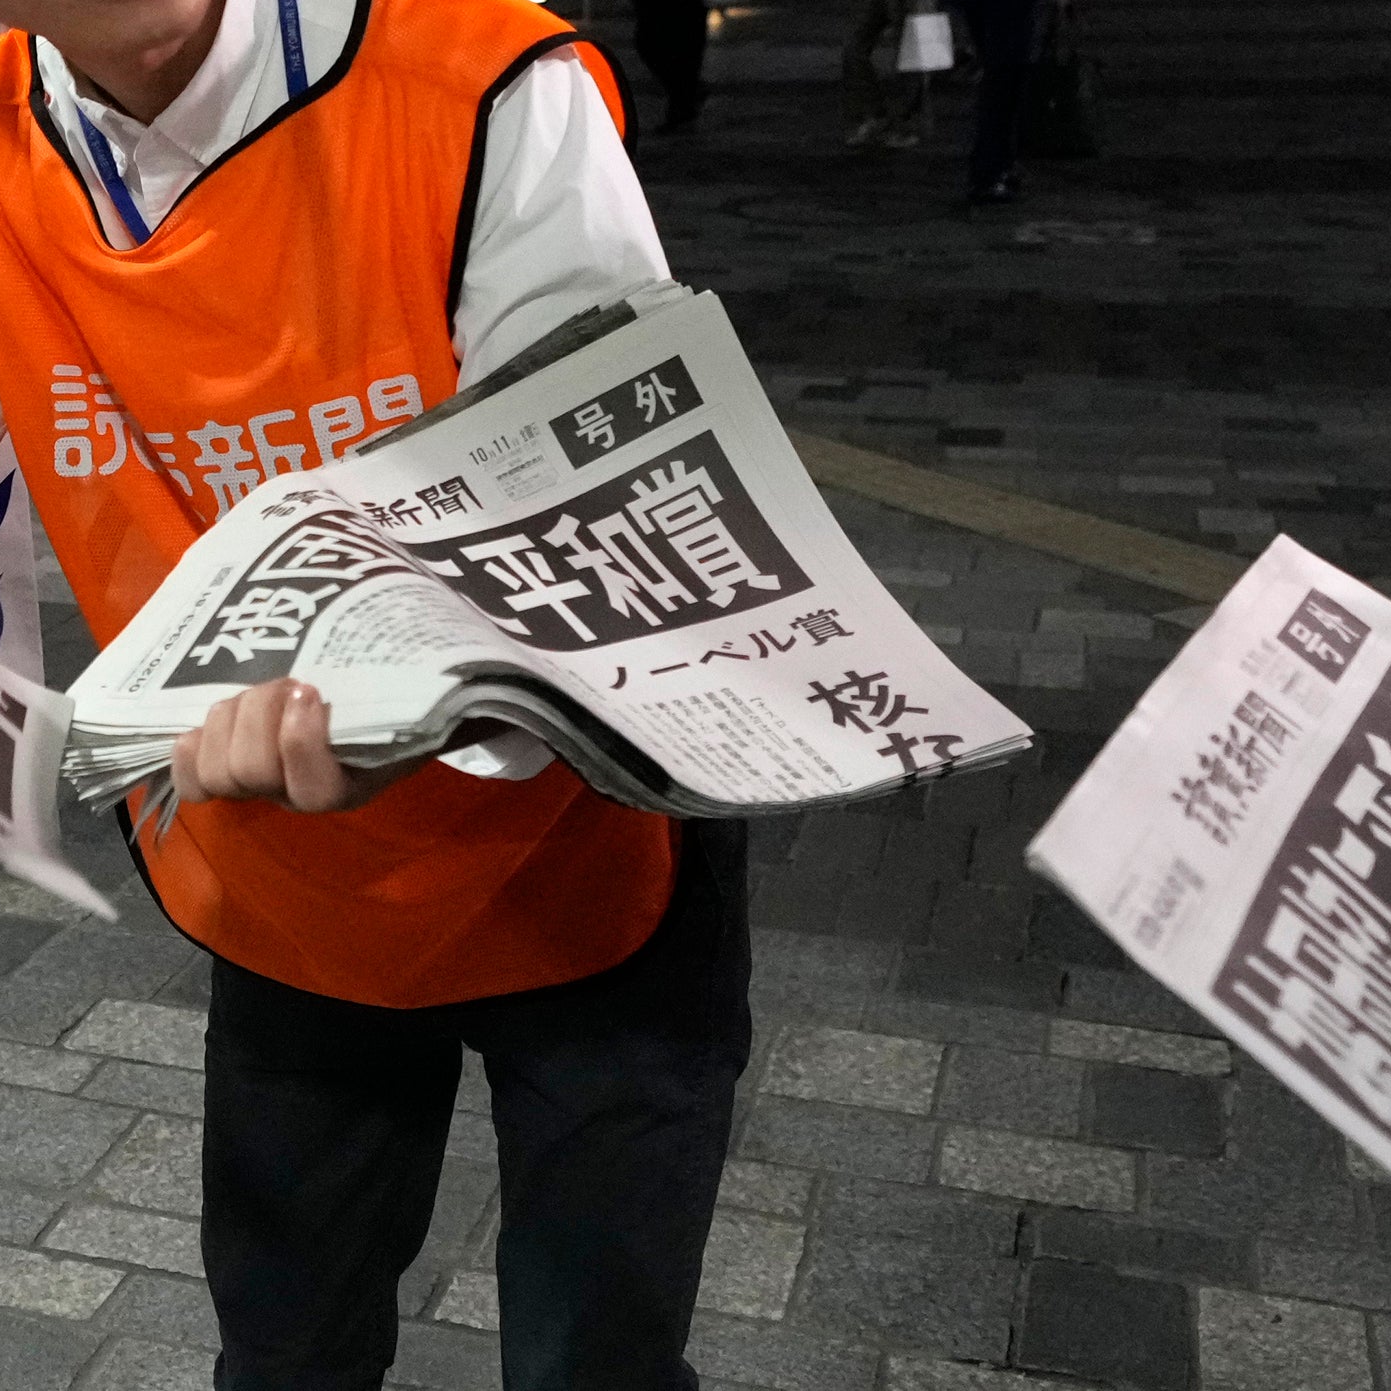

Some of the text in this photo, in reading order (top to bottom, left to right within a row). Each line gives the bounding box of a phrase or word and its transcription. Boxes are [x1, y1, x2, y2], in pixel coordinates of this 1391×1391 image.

[575, 371, 677, 450] 号外
[608, 607, 855, 690] ノーベル賞
